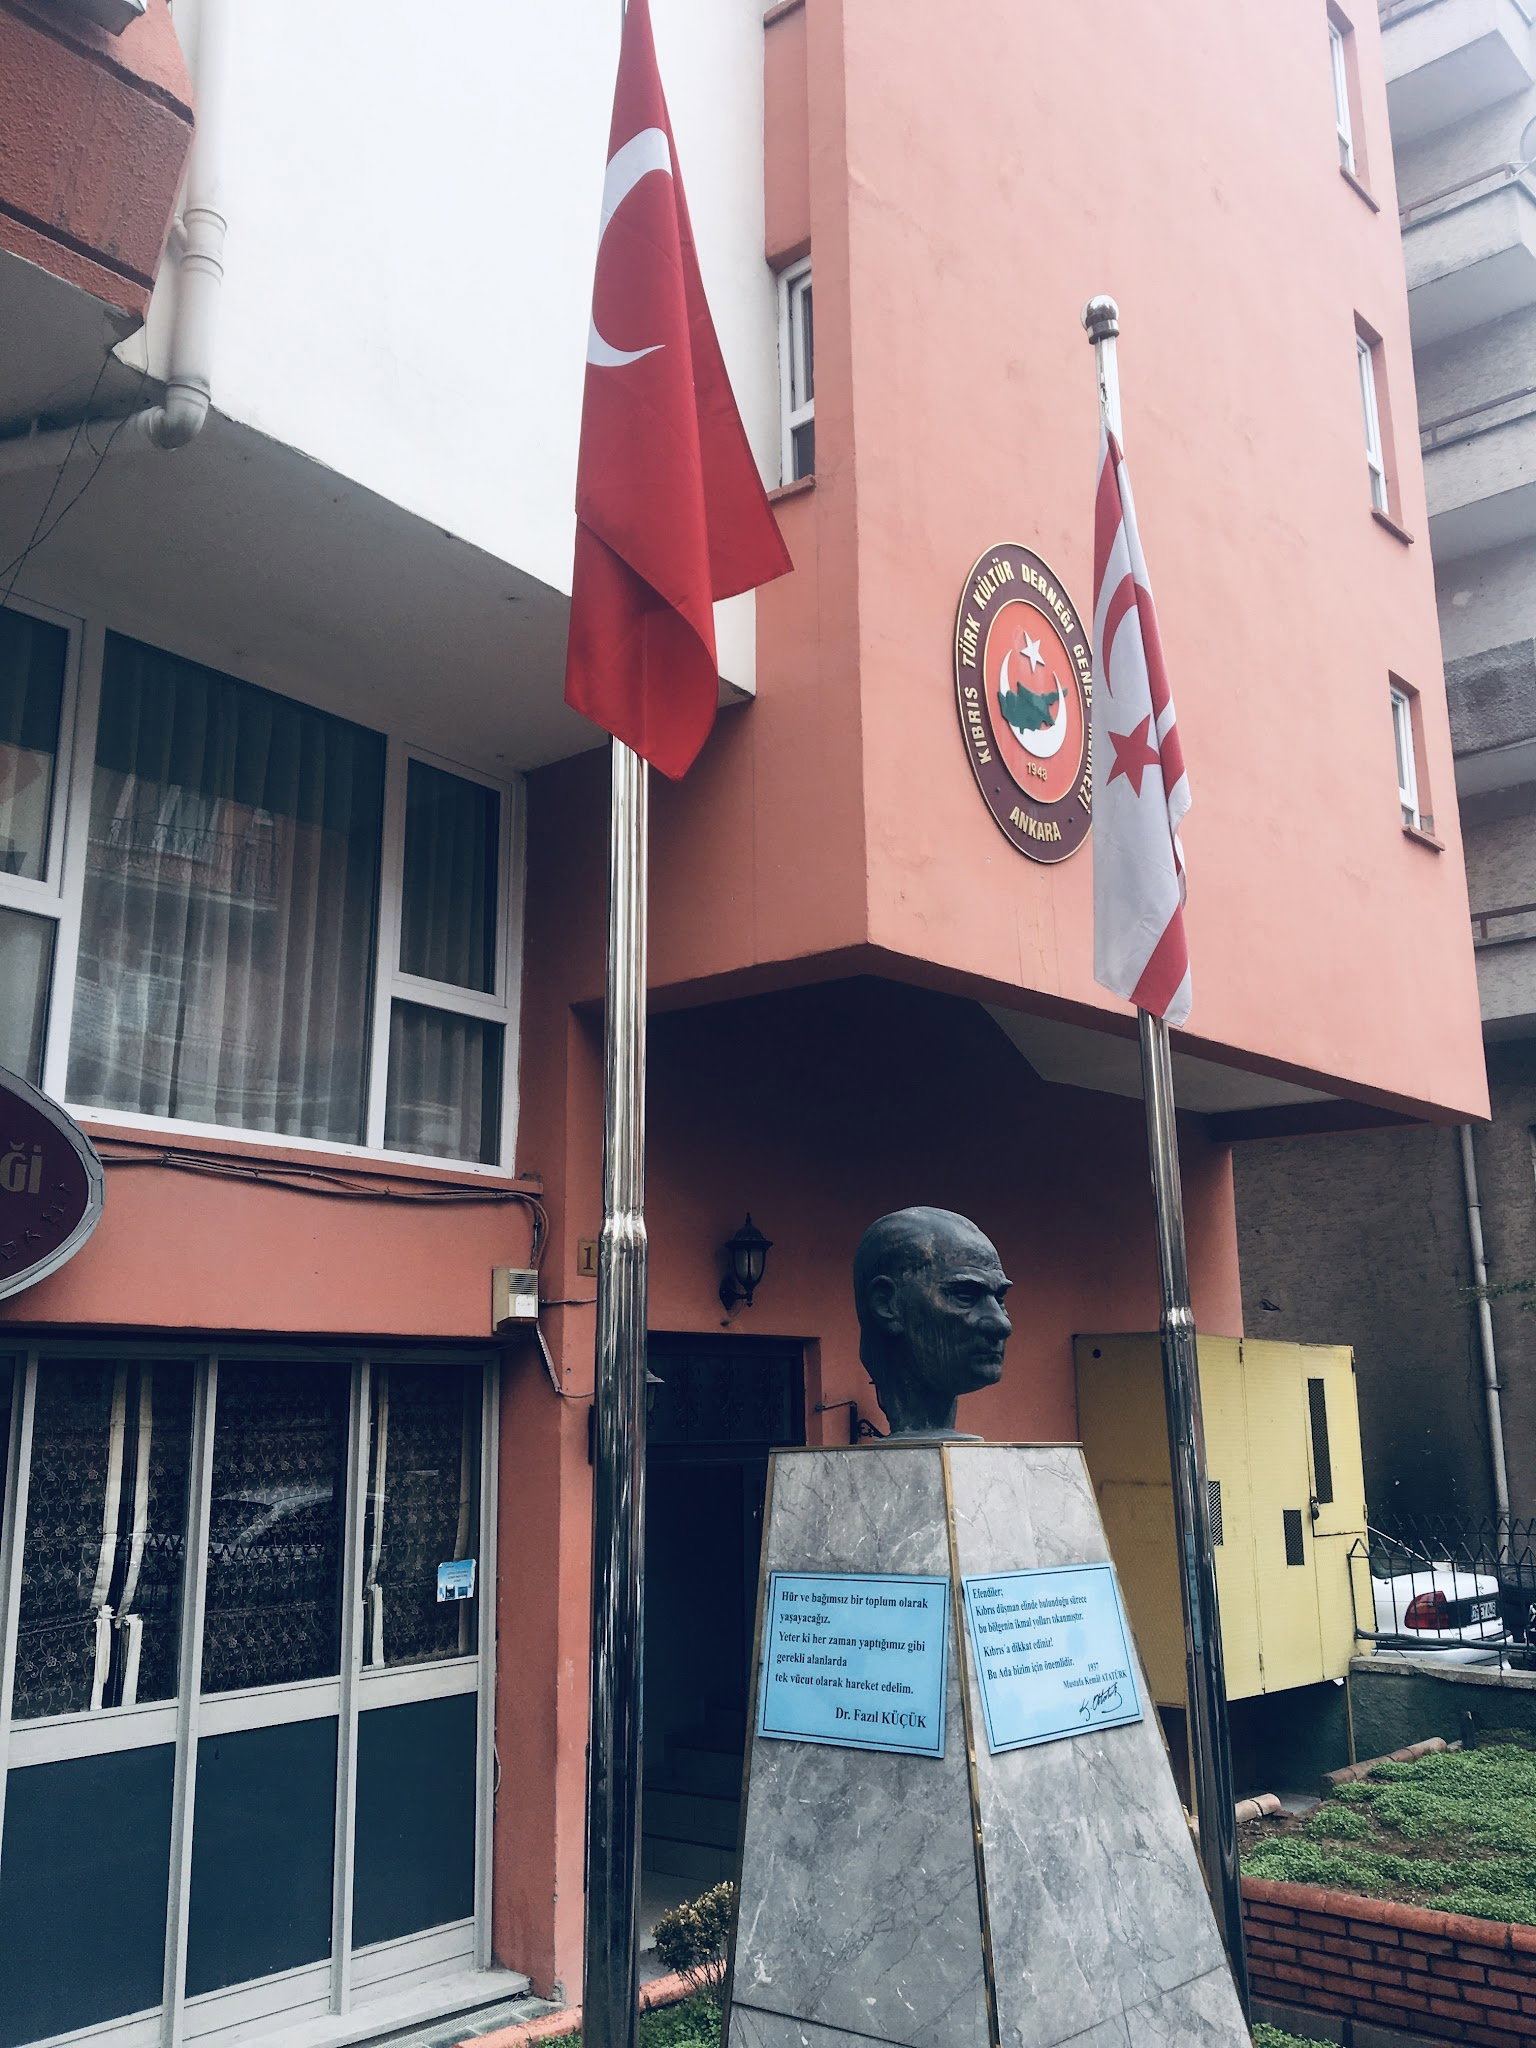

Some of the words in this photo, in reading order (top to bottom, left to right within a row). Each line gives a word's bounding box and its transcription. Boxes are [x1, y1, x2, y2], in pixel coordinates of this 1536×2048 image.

[972, 557, 1014, 611] KÜLTÜR
[959, 613, 981, 669] TÜRK
[965, 687, 992, 764] KIBRIS
[1027, 761, 1048, 781] 1948
[1009, 806, 1061, 841] ANKARA
[782, 1591, 798, 1602] Hür
[801, 1594, 809, 1602] ve
[811, 1593, 848, 1606] bağımsız
[851, 1594, 863, 1605] bir
[865, 1595, 896, 1608] toplum
[899, 1598, 928, 1609] olarak
[996, 1602, 1020, 1615] düşman
[1021, 1600, 1039, 1611] elinde
[779, 1614, 831, 1626] yaşayacağız.
[978, 1623, 987, 1634] bu
[988, 1620, 1014, 1634] bölgenin
[1015, 1618, 1032, 1629] ikmal
[779, 1631, 800, 1643] Yeter
[802, 1632, 810, 1643] ki
[813, 1634, 826, 1645] her
[828, 1637, 857, 1647] zaman
[858, 1637, 905, 1651] yaptığımız
[908, 1640, 925, 1653] gibi
[1012, 1640, 1032, 1653] dikkat
[776, 1653, 805, 1665] gerekli
[807, 1654, 847, 1667] alanlarda
[988, 1669, 997, 1680] Bu
[999, 1667, 1012, 1679] Ada
[1012, 1664, 1031, 1675] bizim
[1031, 1662, 1043, 1675] için
[1101, 1670, 1127, 1682] ATATÜRK
[775, 1672, 788, 1683] tek
[790, 1673, 814, 1685] vücut
[815, 1677, 843, 1688] olarak
[845, 1680, 879, 1691] hareket
[881, 1682, 914, 1695] edelim.
[835, 1707, 851, 1721] Dr.
[854, 1708, 878, 1723] Fazıl
[881, 1709, 927, 1729] KÜÇÜK
